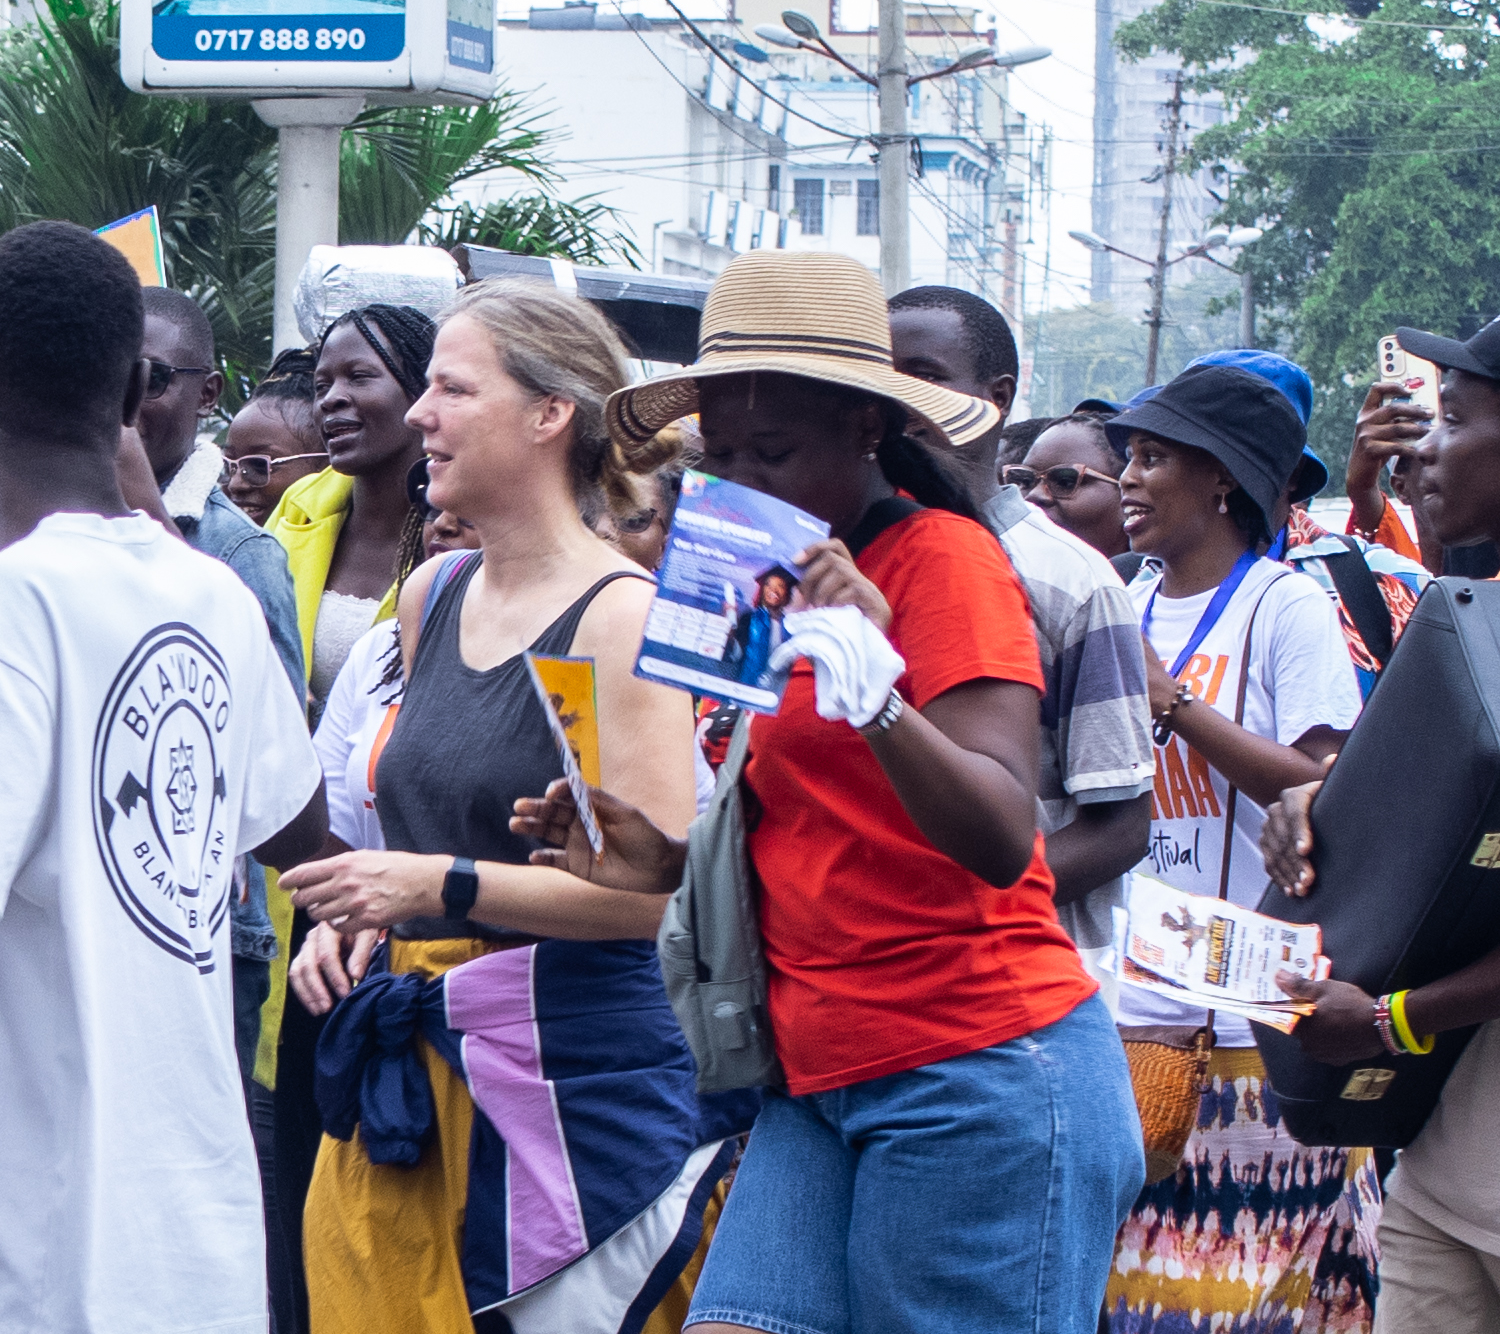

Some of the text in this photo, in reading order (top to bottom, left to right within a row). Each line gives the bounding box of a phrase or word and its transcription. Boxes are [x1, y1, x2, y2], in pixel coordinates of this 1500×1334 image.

[194, 28, 366, 52] 0717 888 890
